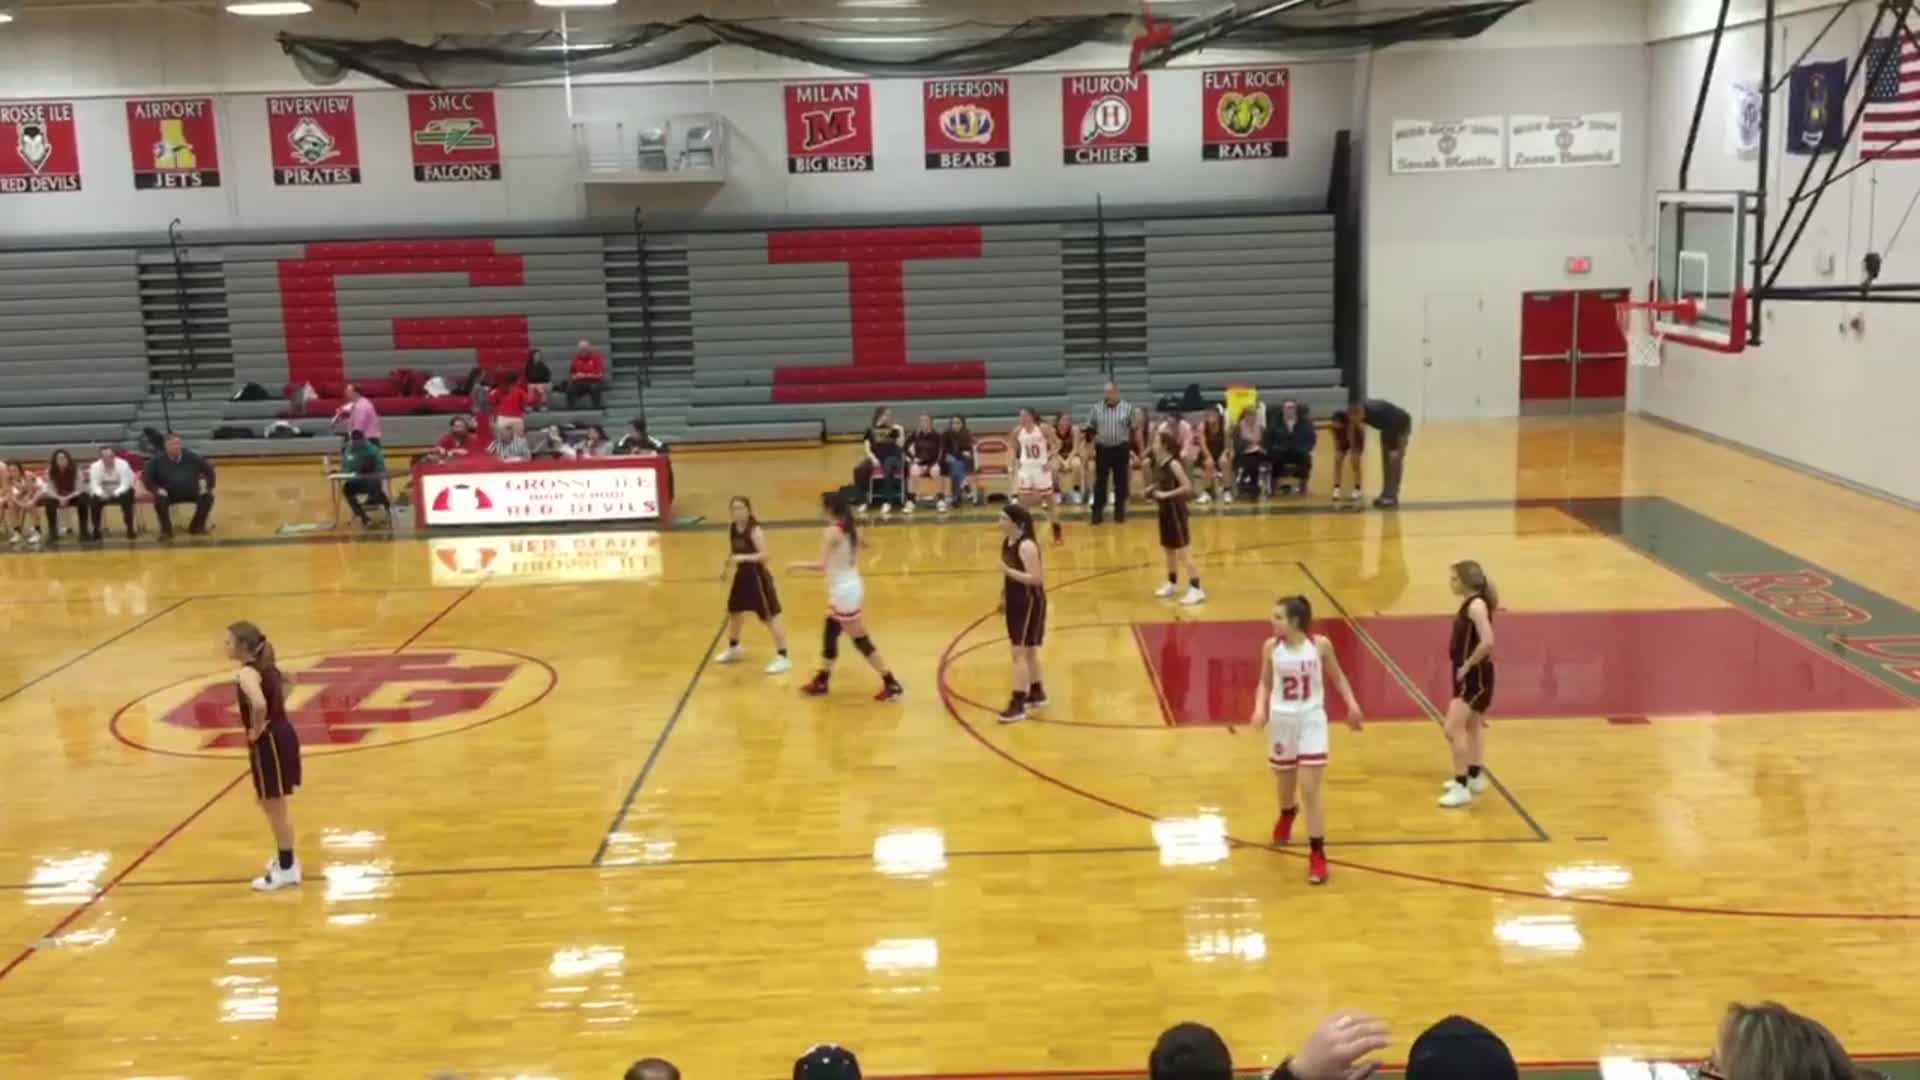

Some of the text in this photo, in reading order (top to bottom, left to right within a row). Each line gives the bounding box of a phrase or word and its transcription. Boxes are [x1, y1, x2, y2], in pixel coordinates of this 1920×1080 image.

[1072, 76, 1139, 94] HURON
[1205, 71, 1286, 88] FLAT ROCK
[796, 85, 859, 103] MILAN
[927, 81, 1005, 99] JEFFERSON
[134, 101, 204, 119] AIRPORT
[271, 97, 350, 115] RIVERVIEW
[429, 95, 473, 112] SMCC
[49, 104, 73, 121] ILE
[939, 153, 997, 168] BEARS
[1075, 147, 1138, 163] CHIEFS
[1219, 144, 1273, 160] RAMS
[795, 156, 867, 172] BIG REDS
[153, 172, 203, 188] JETS
[284, 170, 351, 185] PIRATES
[424, 165, 492, 181] FALCONS
[0, 174, 78, 191] RED DEVILS
[1024, 444, 1041, 460] 10
[1282, 674, 1312, 701] 21
